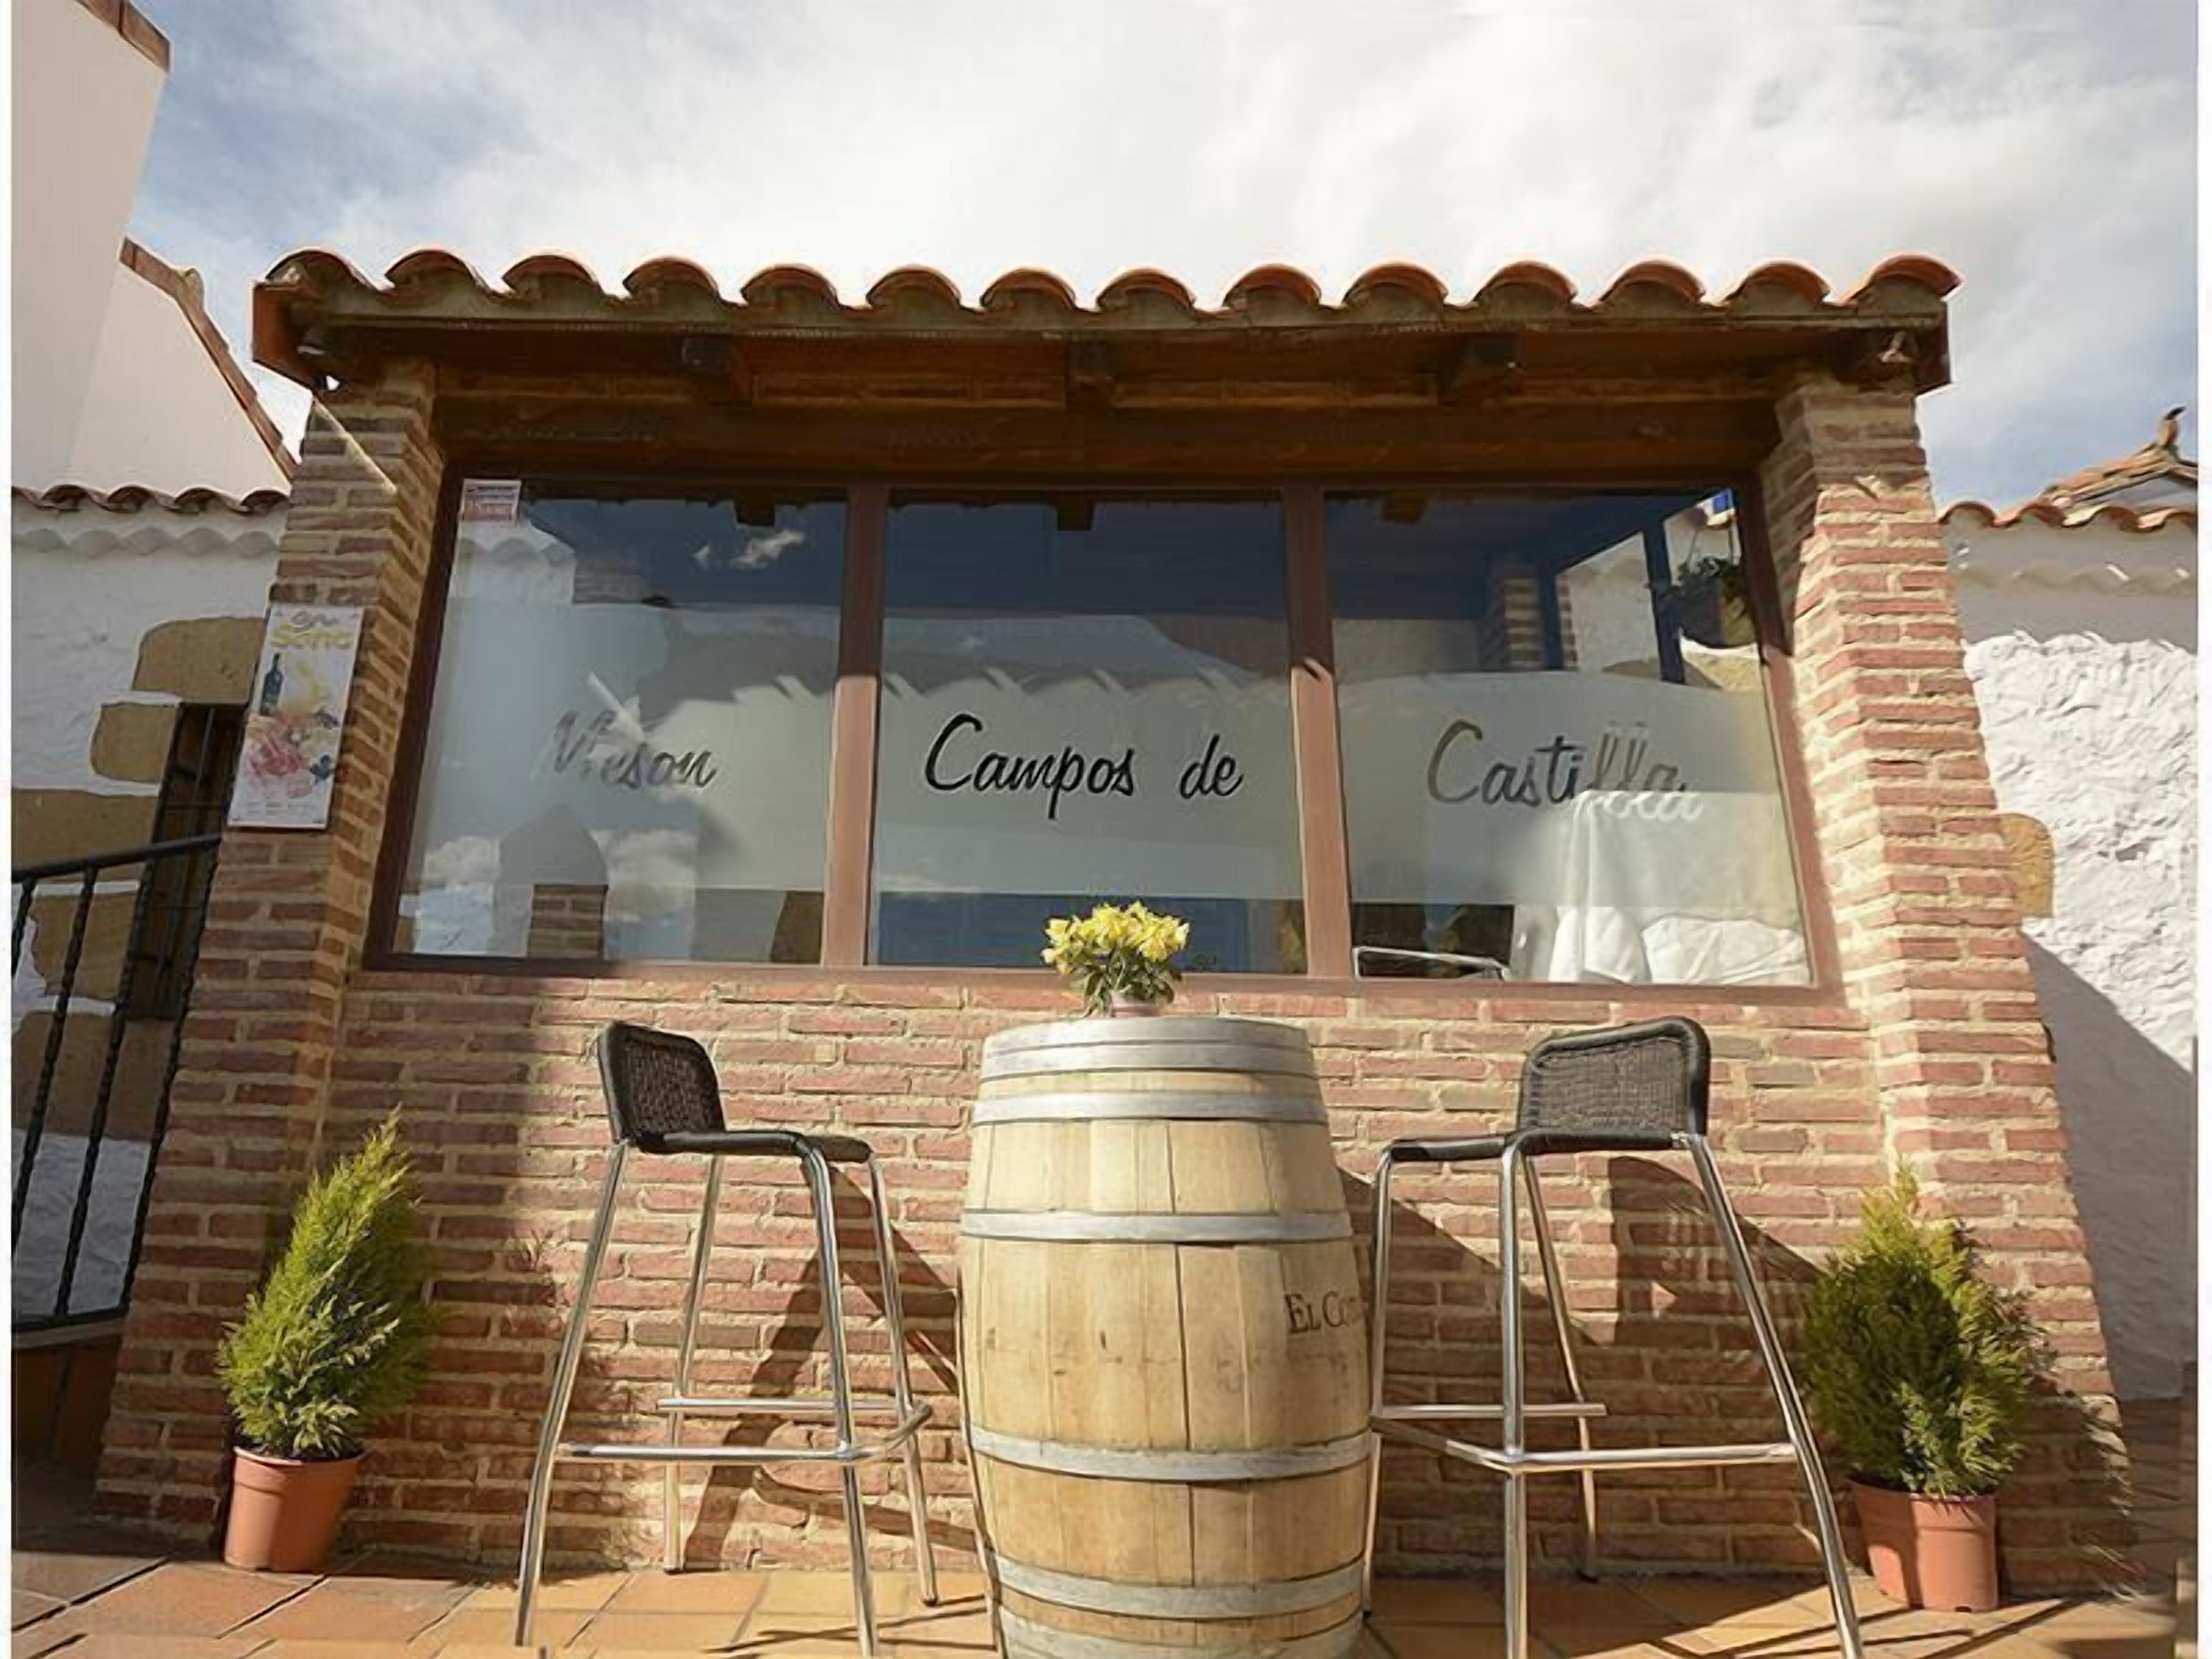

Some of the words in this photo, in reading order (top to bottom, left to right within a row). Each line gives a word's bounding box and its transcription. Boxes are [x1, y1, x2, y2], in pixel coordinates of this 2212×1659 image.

[924, 713, 1135, 821] Campos
[1179, 733, 1244, 799] de
[1427, 718, 1703, 822] Castilla
